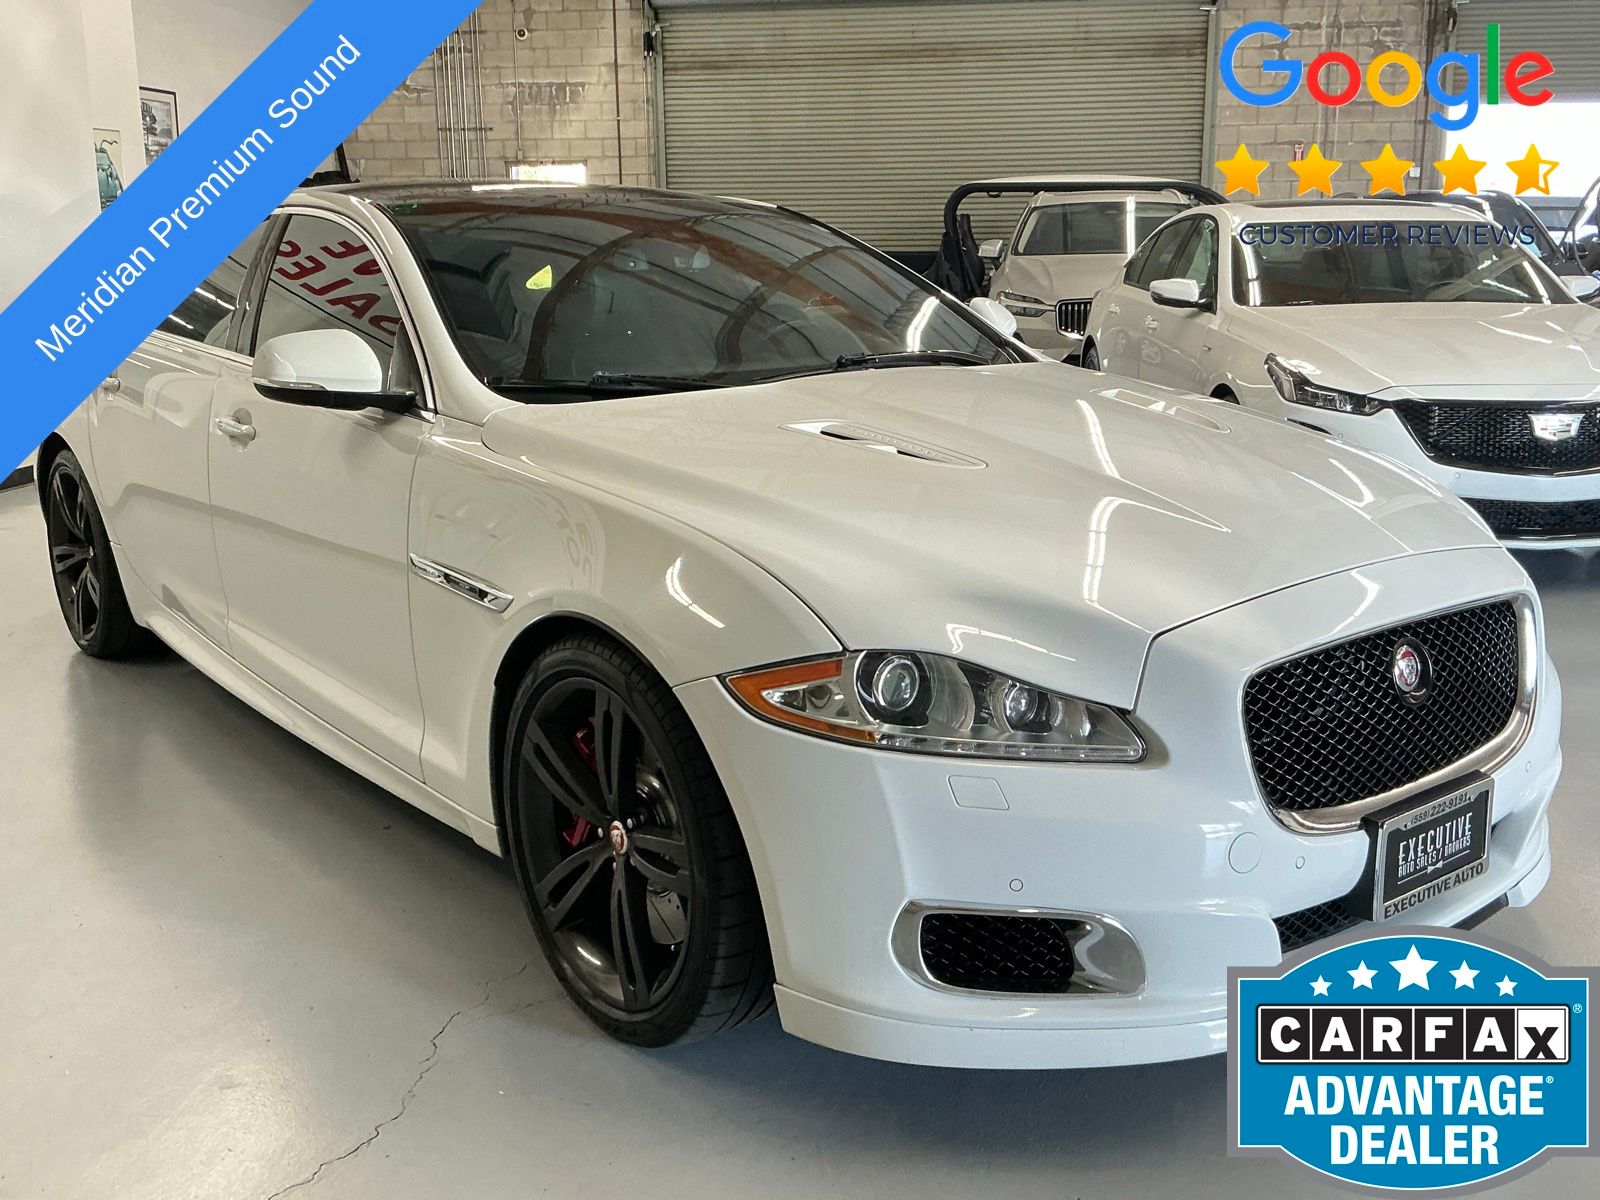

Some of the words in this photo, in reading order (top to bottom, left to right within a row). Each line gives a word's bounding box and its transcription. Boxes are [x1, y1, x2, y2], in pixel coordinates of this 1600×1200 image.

[1398, 860, 1415, 878] AUTO
[1416, 850, 1437, 870] SALES
[1399, 812, 1473, 866] EXECUTIVE
[1384, 879, 1450, 919] EXECUTIVE
[1453, 862, 1484, 887] AUTO
